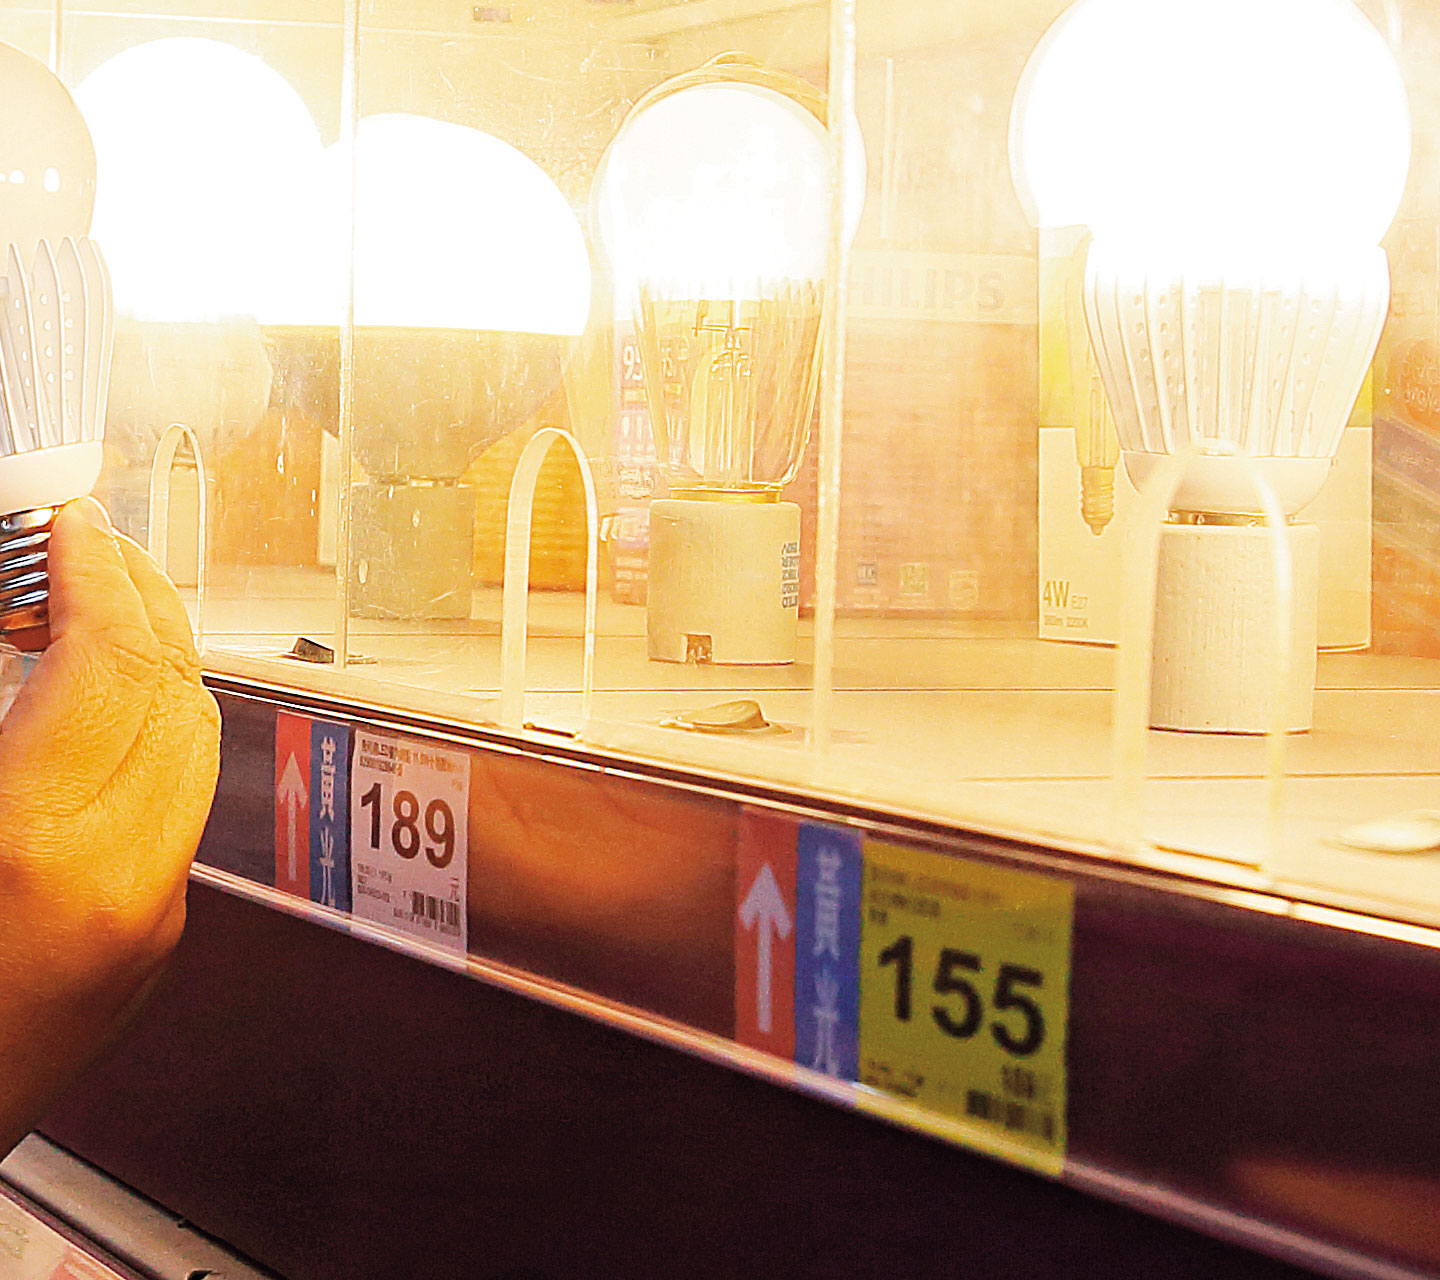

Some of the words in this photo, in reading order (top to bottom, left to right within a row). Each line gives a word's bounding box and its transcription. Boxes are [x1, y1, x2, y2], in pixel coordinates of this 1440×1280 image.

[848, 267, 1006, 312] HILIPS
[1043, 580, 1070, 608] 4W
[360, 782, 456, 869] 189
[878, 935, 1046, 1057] 155
